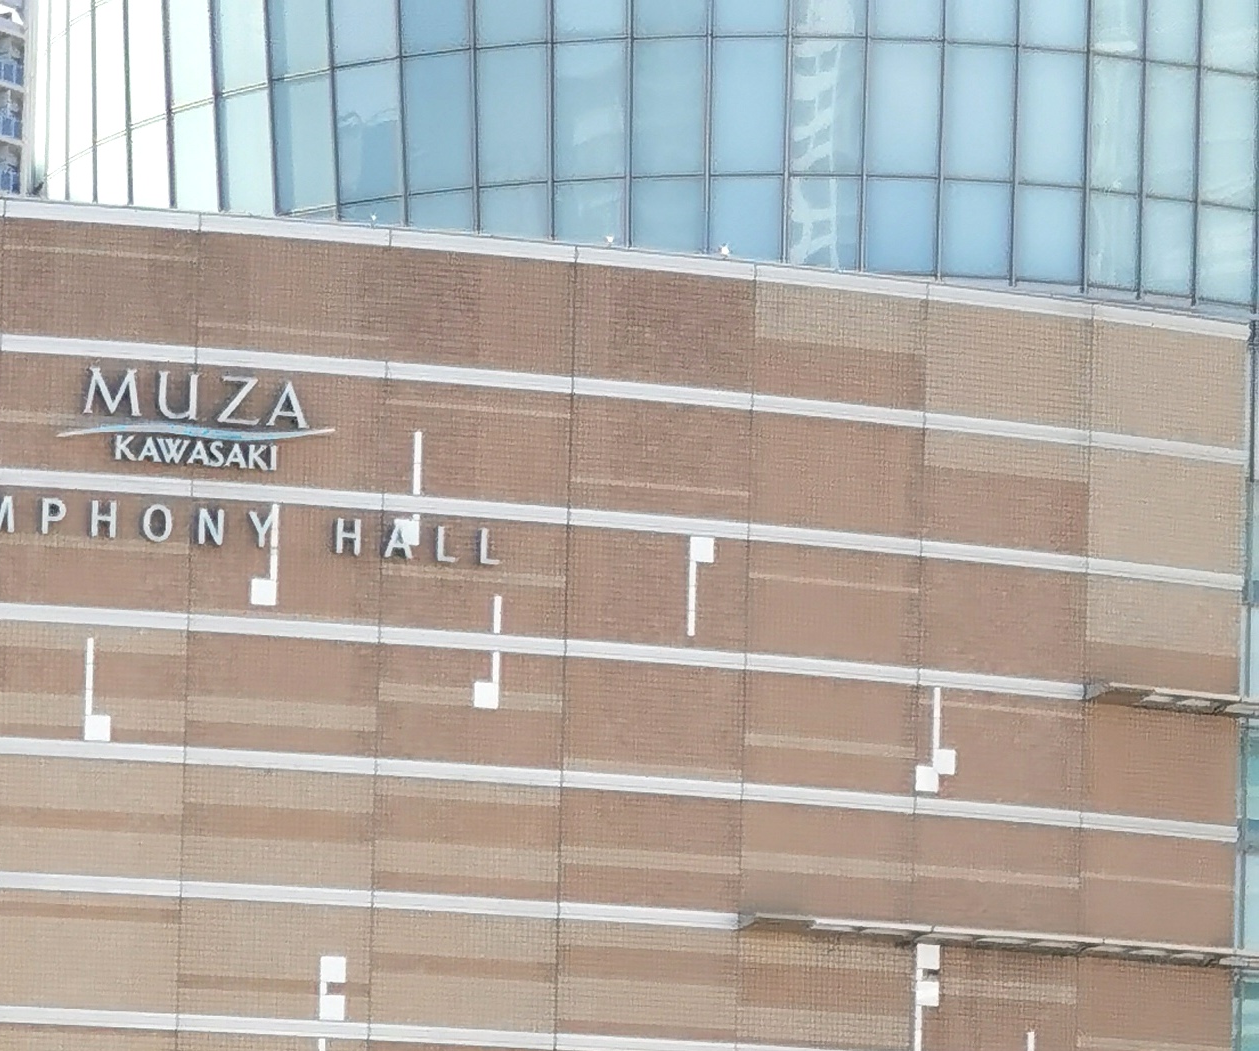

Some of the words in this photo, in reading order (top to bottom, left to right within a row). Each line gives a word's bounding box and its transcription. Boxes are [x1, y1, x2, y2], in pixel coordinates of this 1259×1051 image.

[82, 367, 310, 429] MUZA
[114, 434, 278, 471] KAWASAKI
[335, 516, 501, 566] HALL
